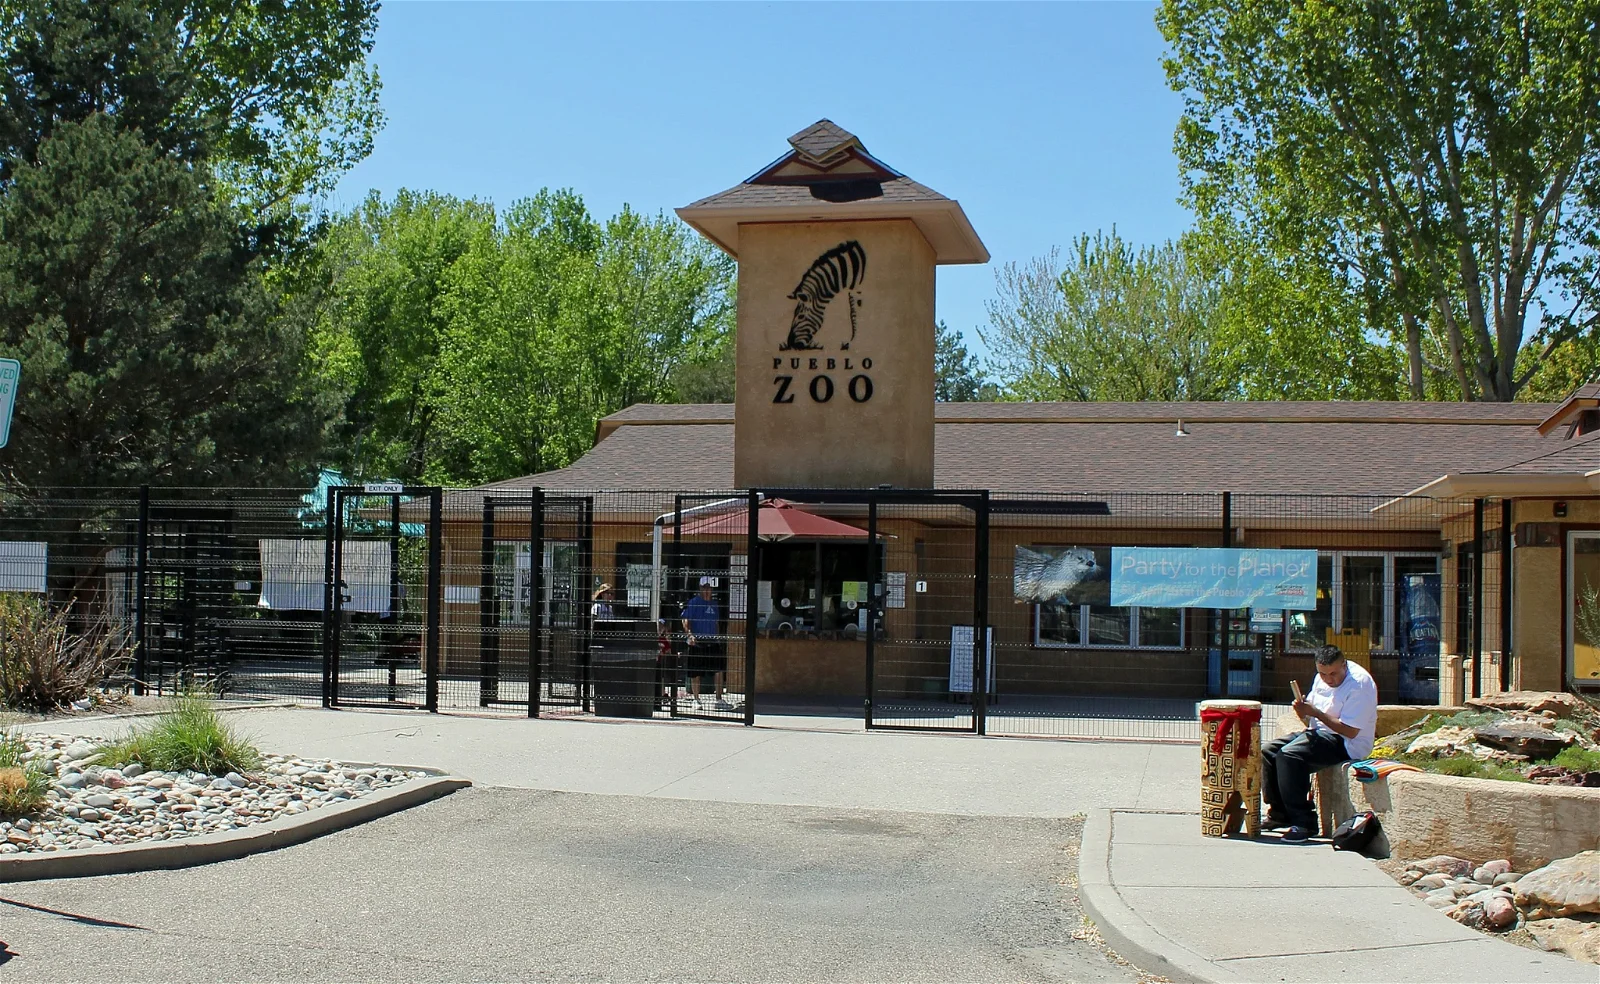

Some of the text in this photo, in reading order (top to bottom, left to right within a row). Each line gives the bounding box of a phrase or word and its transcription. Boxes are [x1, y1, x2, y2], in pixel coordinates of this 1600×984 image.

[772, 358, 873, 370] PUEBLO
[772, 375, 874, 404] ZOO
[1121, 556, 1310, 579] Party for the Planet
[919, 582, 924, 591] 1
[1213, 587, 1244, 597] Pueblo
